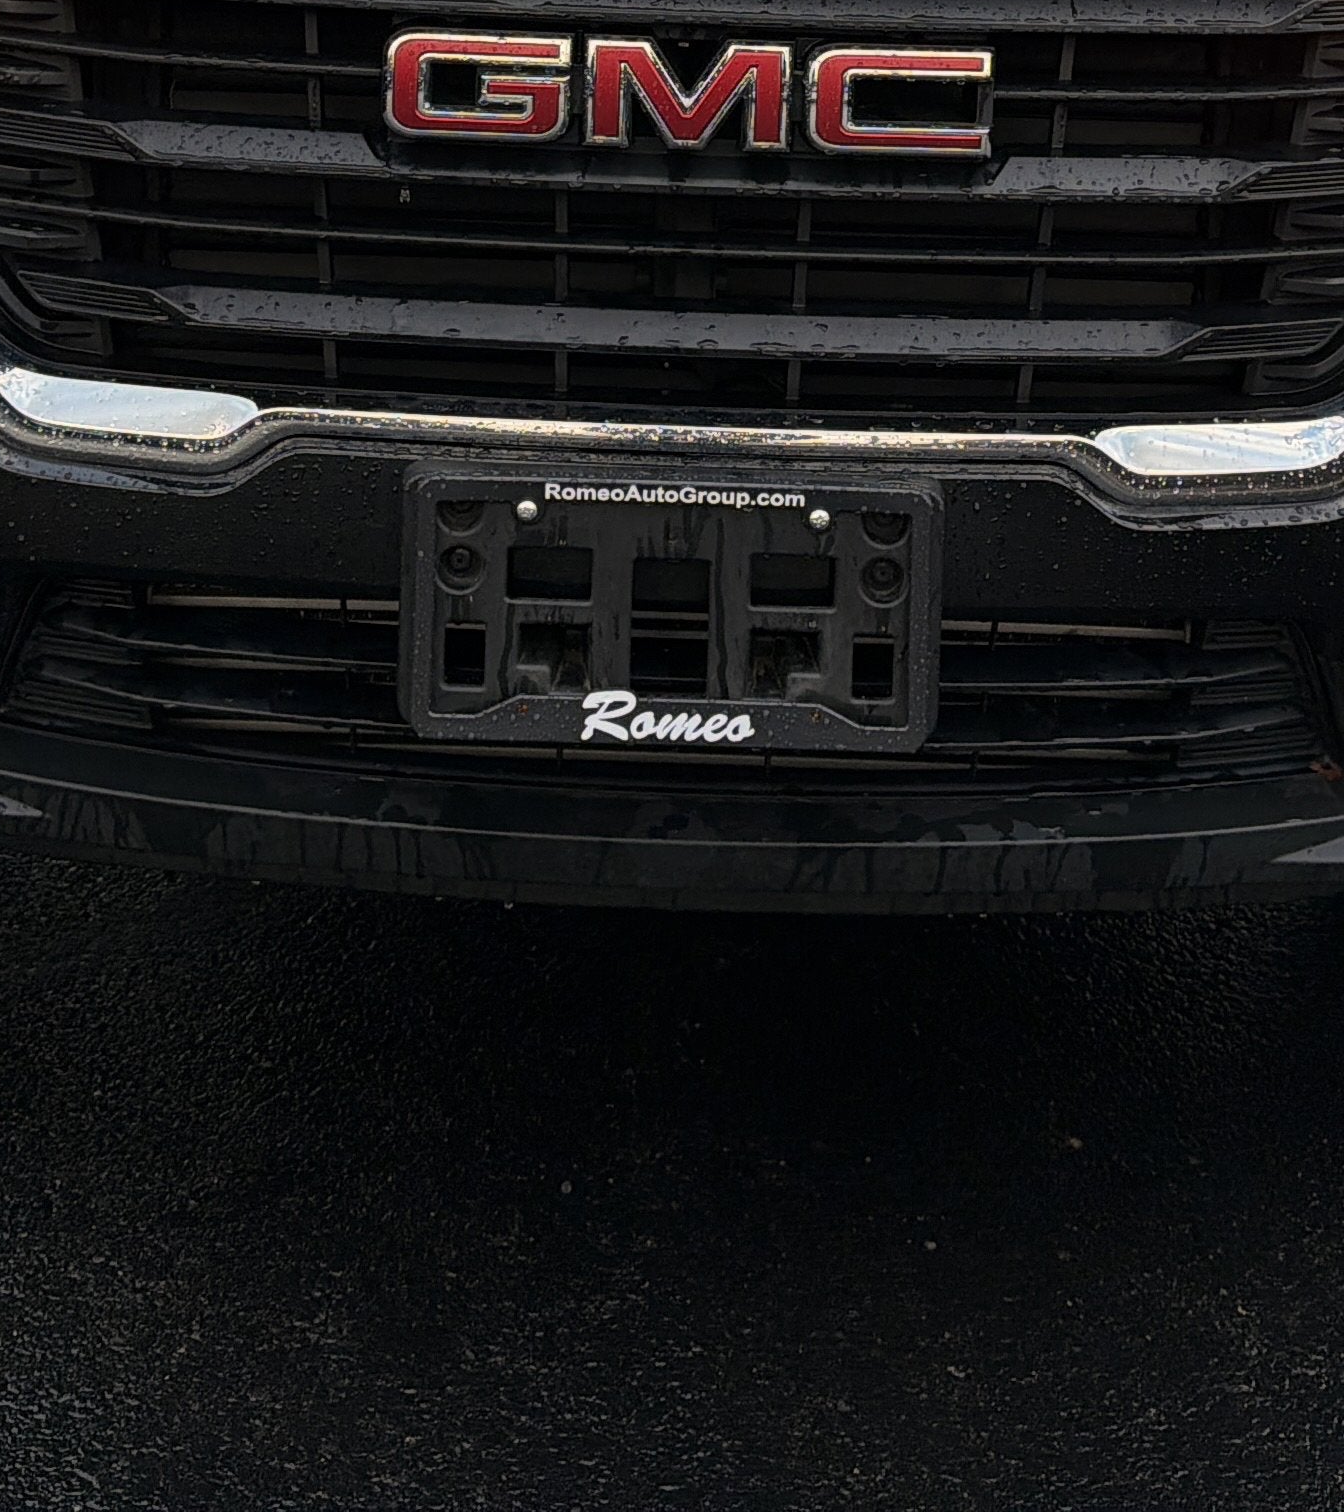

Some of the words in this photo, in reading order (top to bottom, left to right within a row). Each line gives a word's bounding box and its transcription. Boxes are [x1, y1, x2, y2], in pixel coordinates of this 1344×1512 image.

[385, 32, 995, 159] GMC
[544, 482, 806, 509] RomeoAutoGroup.com
[580, 690, 756, 743] Romeo
